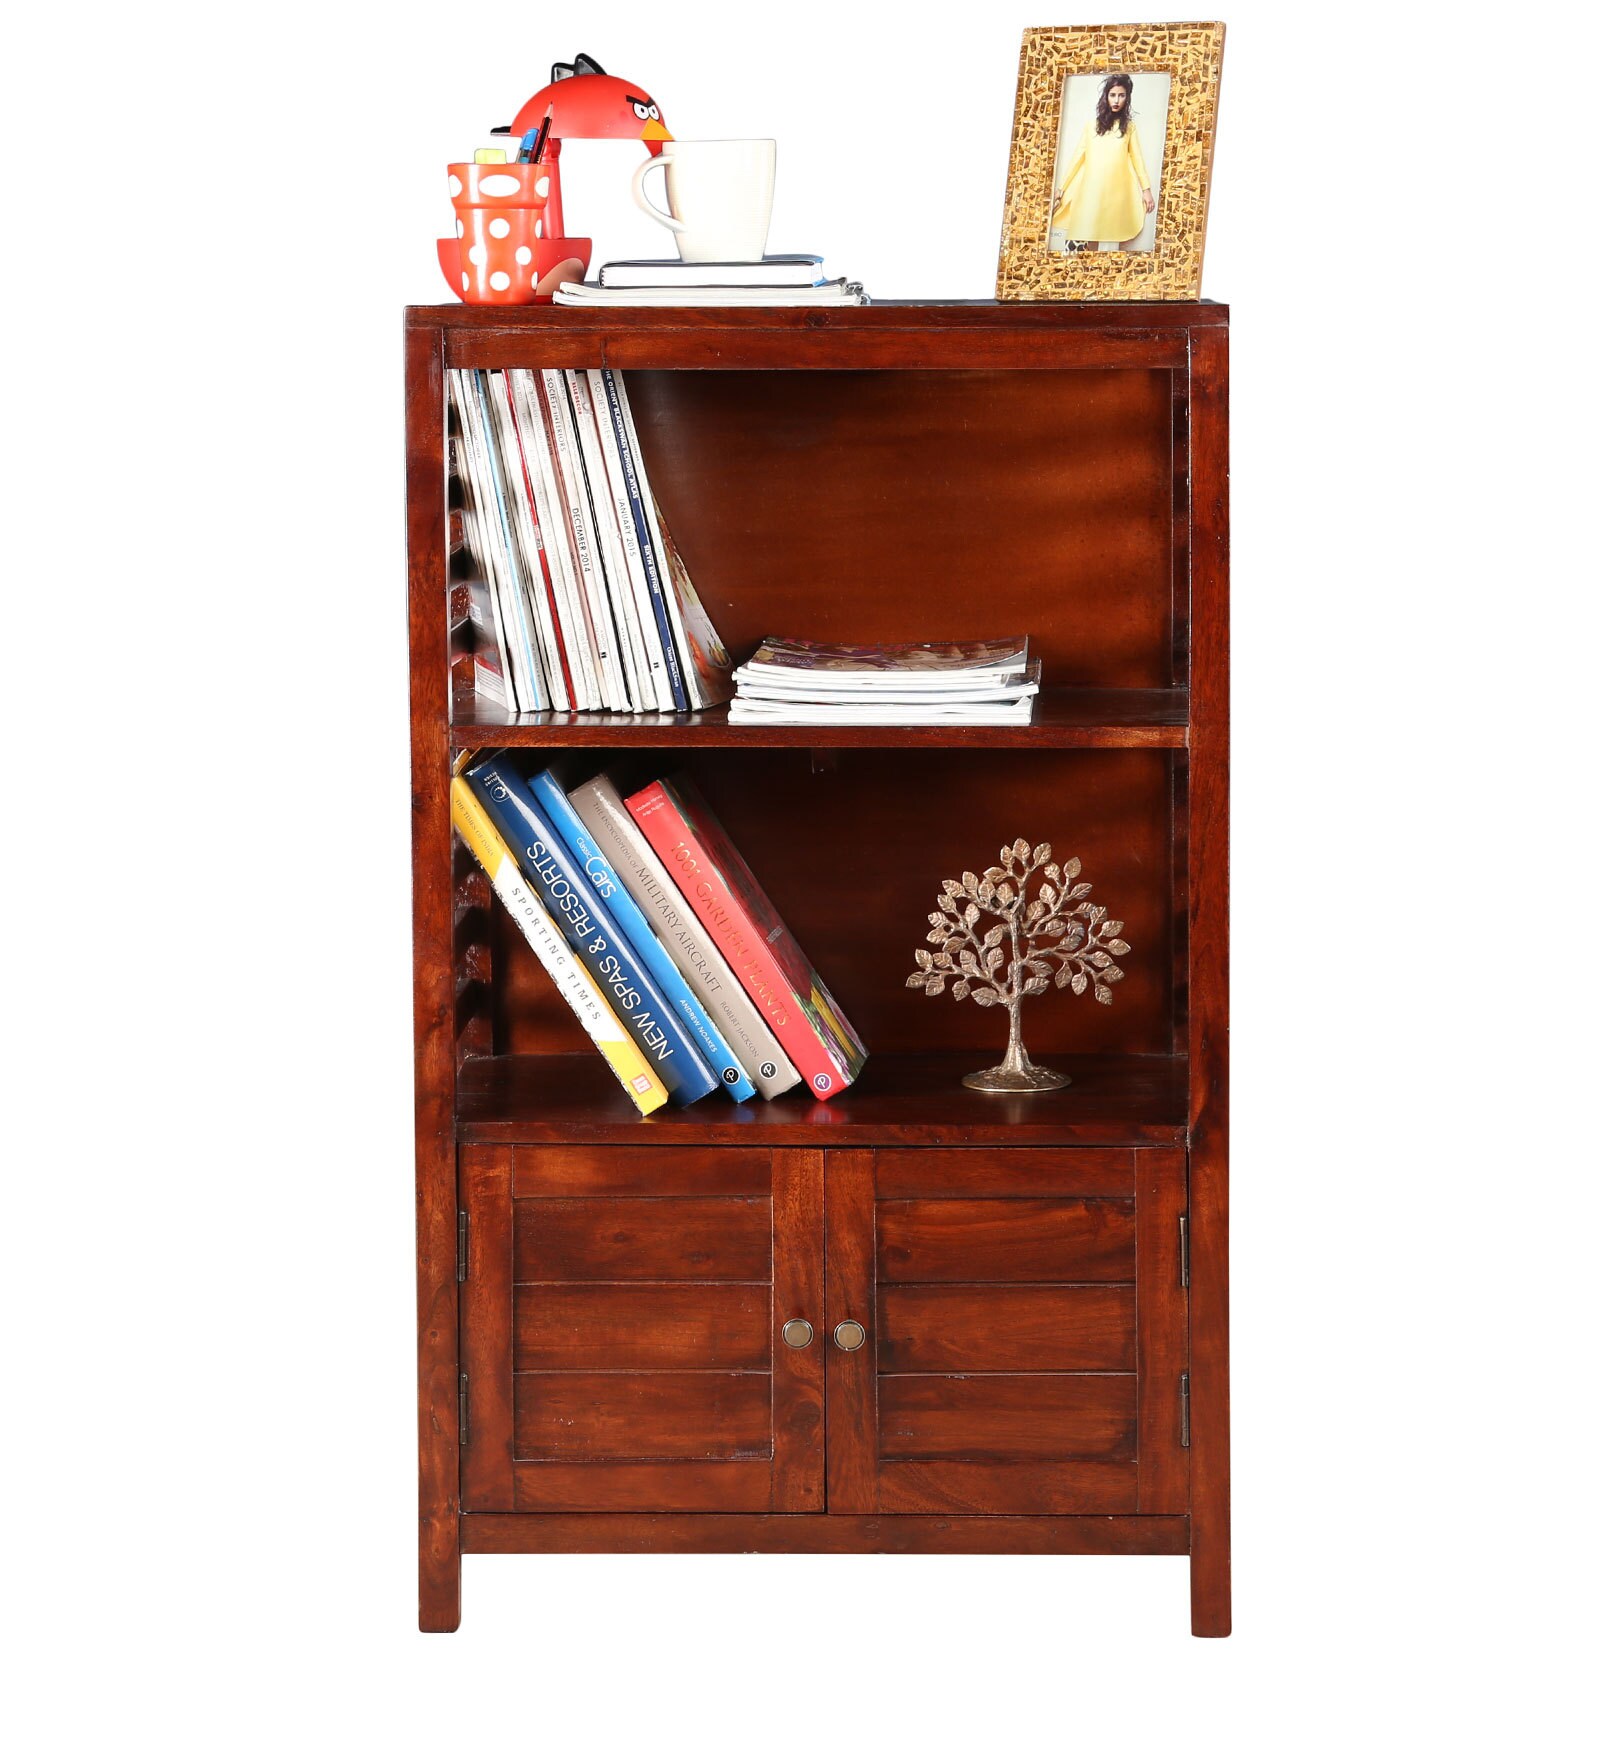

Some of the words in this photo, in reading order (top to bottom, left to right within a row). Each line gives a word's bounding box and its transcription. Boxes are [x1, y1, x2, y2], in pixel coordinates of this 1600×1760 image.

[546, 377, 558, 408] SOCIETY
[552, 411, 566, 451] INTERIORS
[593, 380, 607, 415] SOCIETY
[601, 416, 615, 458] INTERIORS
[607, 381, 618, 405] ORIENT
[612, 407, 627, 448] BLACKSWAN
[621, 449, 633, 476] SCHOOL
[628, 477, 639, 499] ATLAS
[571, 507, 586, 551] DECEMBER
[580, 552, 590, 572] 2014
[617, 497, 631, 535] JANUARY
[626, 536, 636, 557] 2015
[642, 544, 652, 565] SIXTH
[647, 565, 659, 594] EDITION
[455, 799, 465, 810] THE
[462, 811, 477, 830] TIMES
[592, 802, 603, 815] THE
[629, 859, 638, 869] OF
[575, 836, 593, 859] Classic
[524, 838, 596, 938] RESORTS
[581, 852, 618, 900] Cars
[511, 886, 566, 966] SPORTING
[566, 971, 601, 1021] TIMES
[585, 934, 608, 957] &
[634, 866, 682, 931] MILITARY
[674, 928, 723, 995] AIRCRAFT
[669, 840, 701, 879] 1001
[693, 879, 750, 958] GARDEN
[741, 957, 793, 1027] PLANTS
[597, 952, 643, 1012] SPAS
[631, 1007, 674, 1061] NEW
[679, 998, 701, 1026] ANDREW
[696, 1025, 717, 1053] NOAKES
[719, 1000, 739, 1027] ROBERT
[735, 1026, 759, 1057] JACKSON
